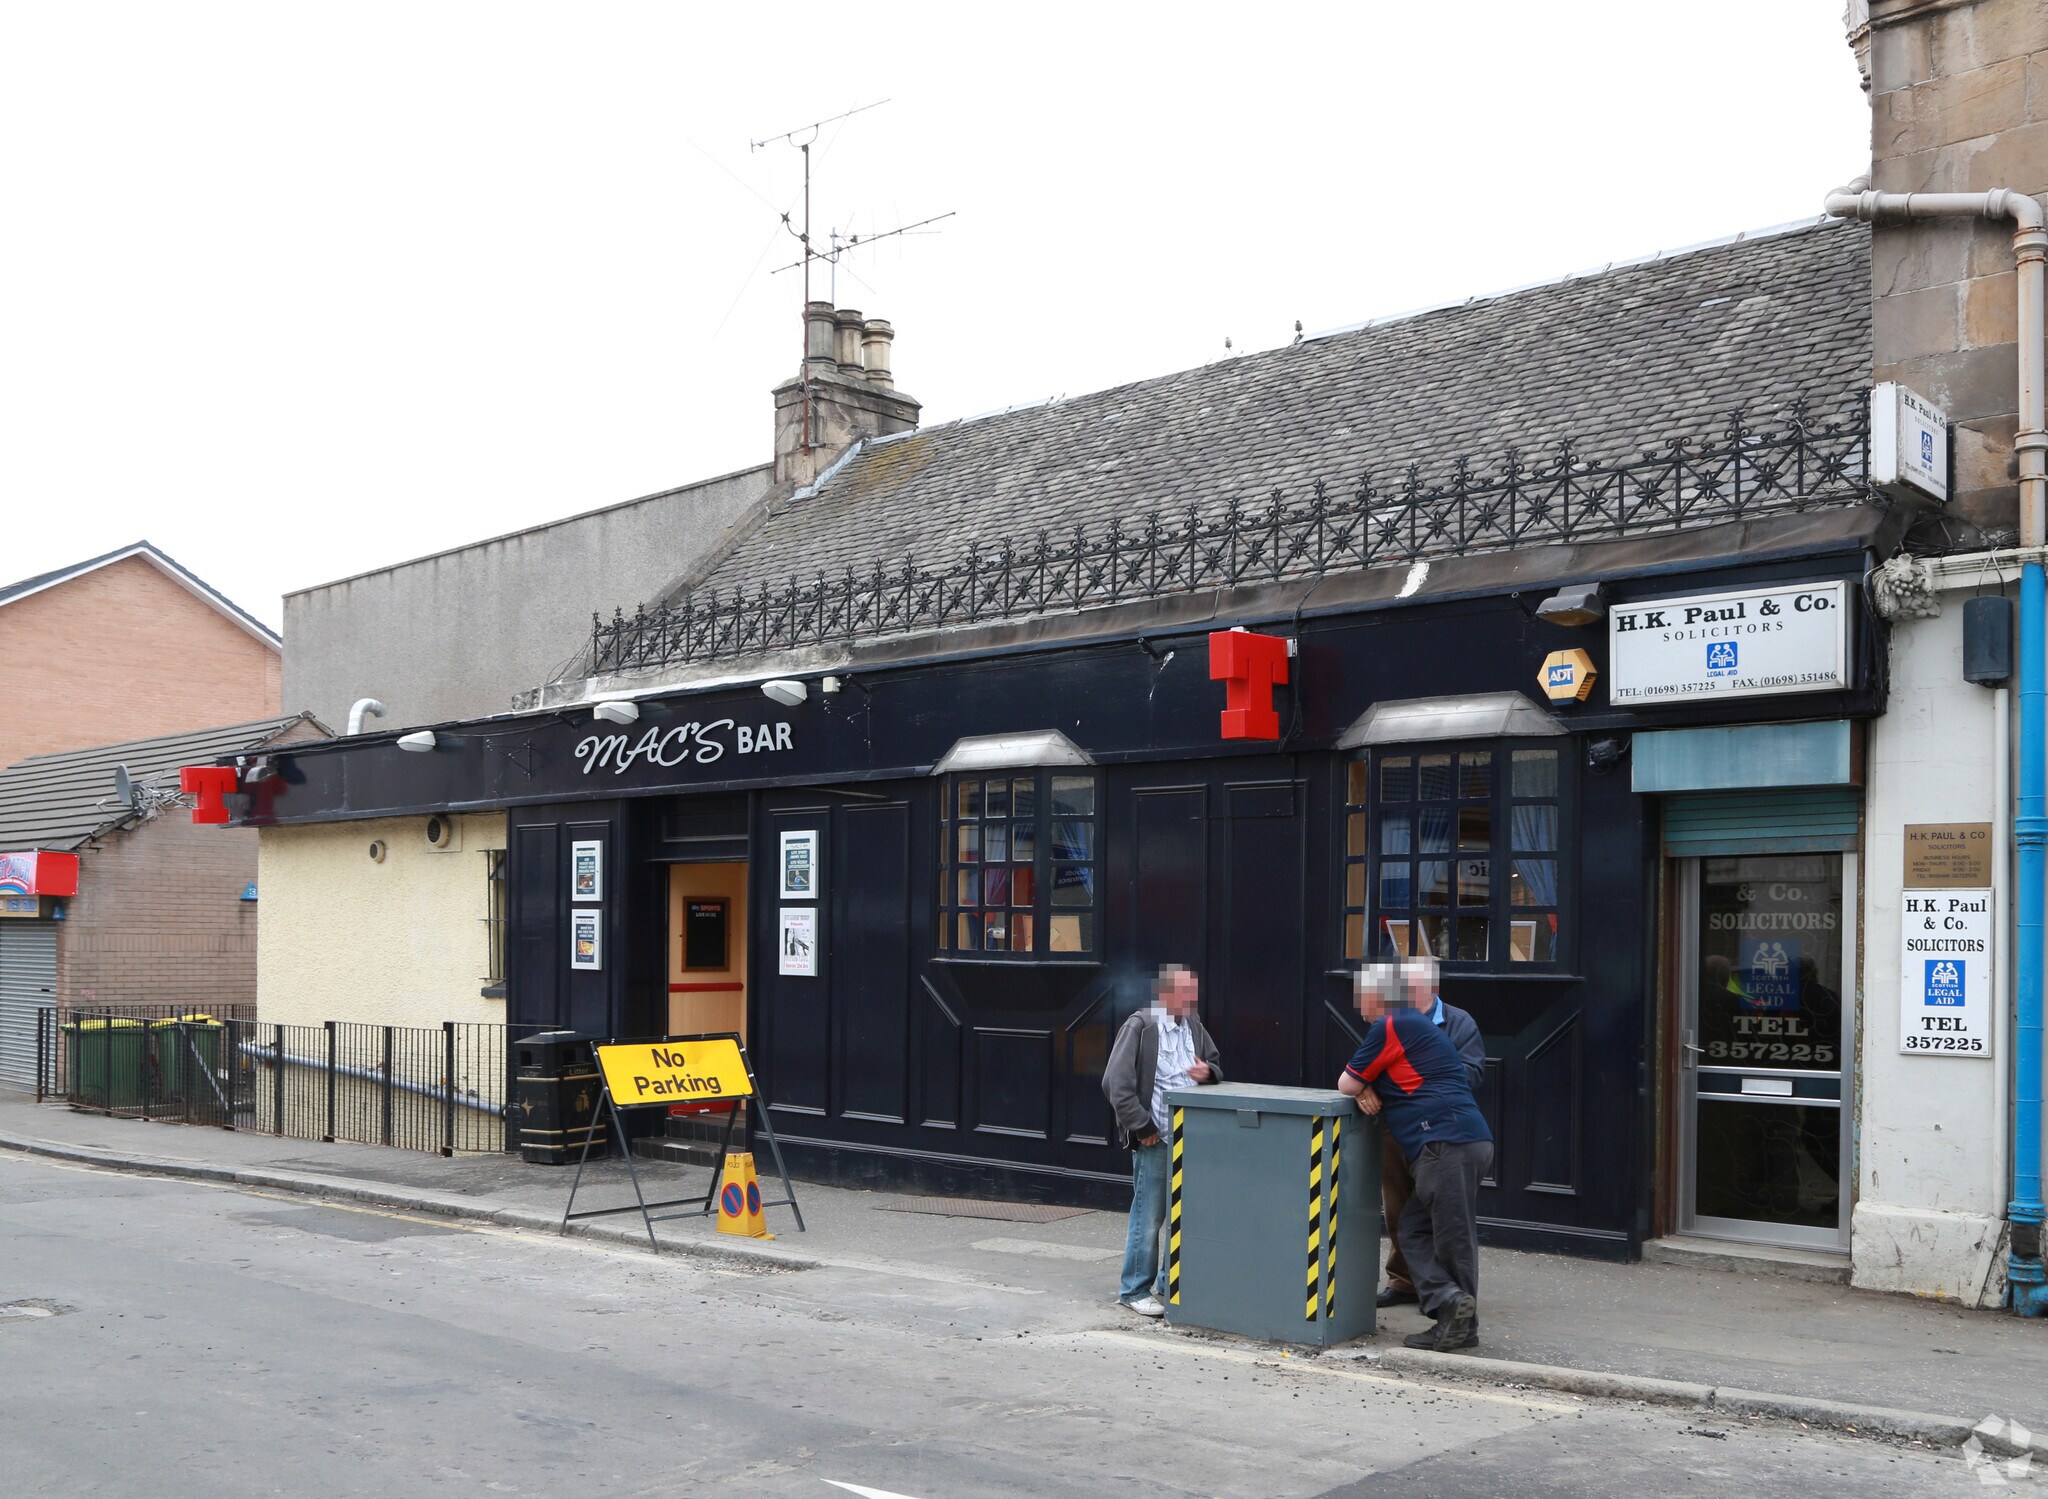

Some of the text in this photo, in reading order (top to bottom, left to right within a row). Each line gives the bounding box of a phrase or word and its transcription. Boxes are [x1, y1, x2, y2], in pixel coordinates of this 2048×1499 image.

[1616, 594, 1836, 633] H.K. Paul & Co.
[1663, 621, 1784, 642] SOLICITORS
[1549, 668, 1573, 682] ADT
[1617, 671, 1837, 697] TEL: (01698) 357225 FAX: (01698) 351486
[574, 718, 793, 775] MAC'S BAR
[1931, 832, 1955, 840] PAUL
[1959, 831, 1966, 839] &
[1970, 831, 1986, 839] CO
[1736, 883, 1808, 901] & Co.
[1906, 899, 1987, 913] H.K. Paul
[1709, 912, 1836, 930] SOLICITORS
[1923, 917, 1968, 930] & Co.
[1907, 939, 1985, 952] SOLICITORS
[1746, 983, 1795, 994] LEGAL
[1927, 989, 1963, 997] LEGAL
[1757, 996, 1784, 1007] AID
[1935, 997, 1955, 1005] AID
[1732, 1015, 1809, 1037] TEL
[1921, 1017, 1967, 1032] TEL
[1906, 1036, 1983, 1051] 357225
[651, 1048, 686, 1068] No
[1709, 1041, 1834, 1063] 357225
[569, 1067, 589, 1076] Litter
[633, 1074, 722, 1096] Parking
